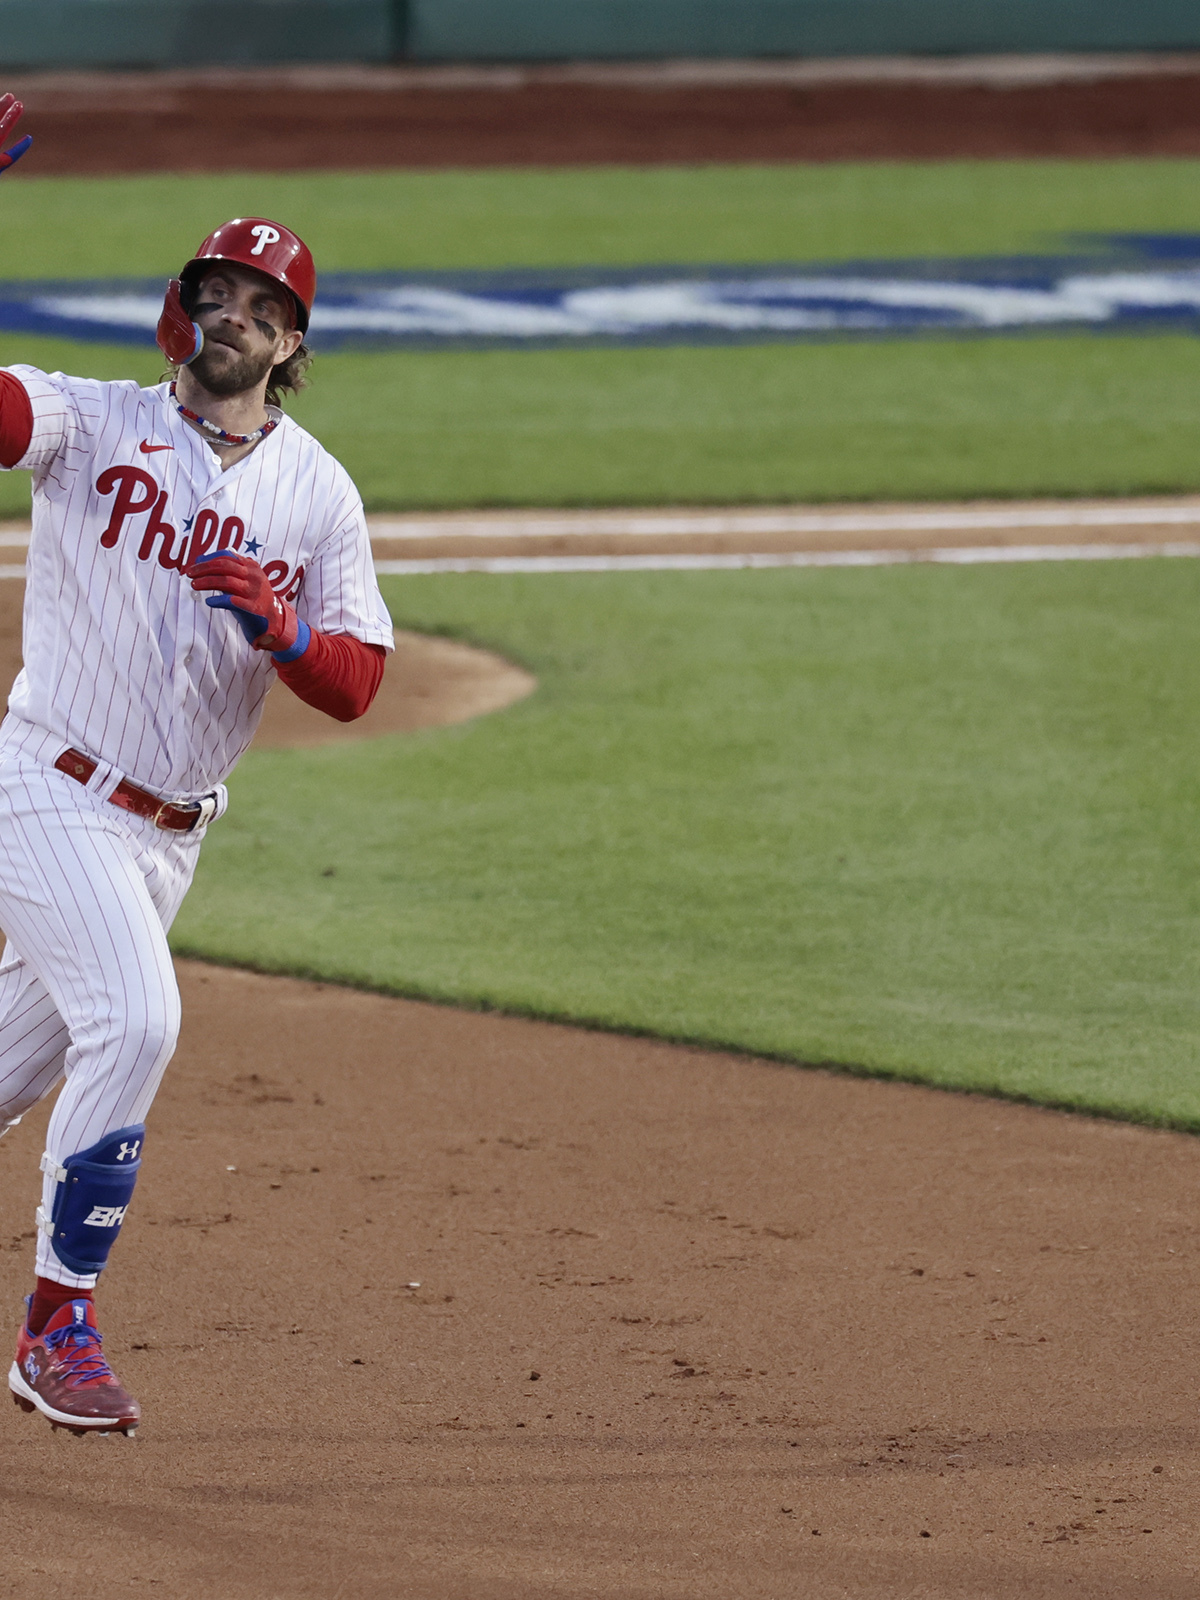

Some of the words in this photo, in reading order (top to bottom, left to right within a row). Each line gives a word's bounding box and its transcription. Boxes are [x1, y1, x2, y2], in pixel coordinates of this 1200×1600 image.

[250, 224, 280, 255] P
[95, 465, 305, 602] Philles
[82, 1203, 130, 1228] BH
